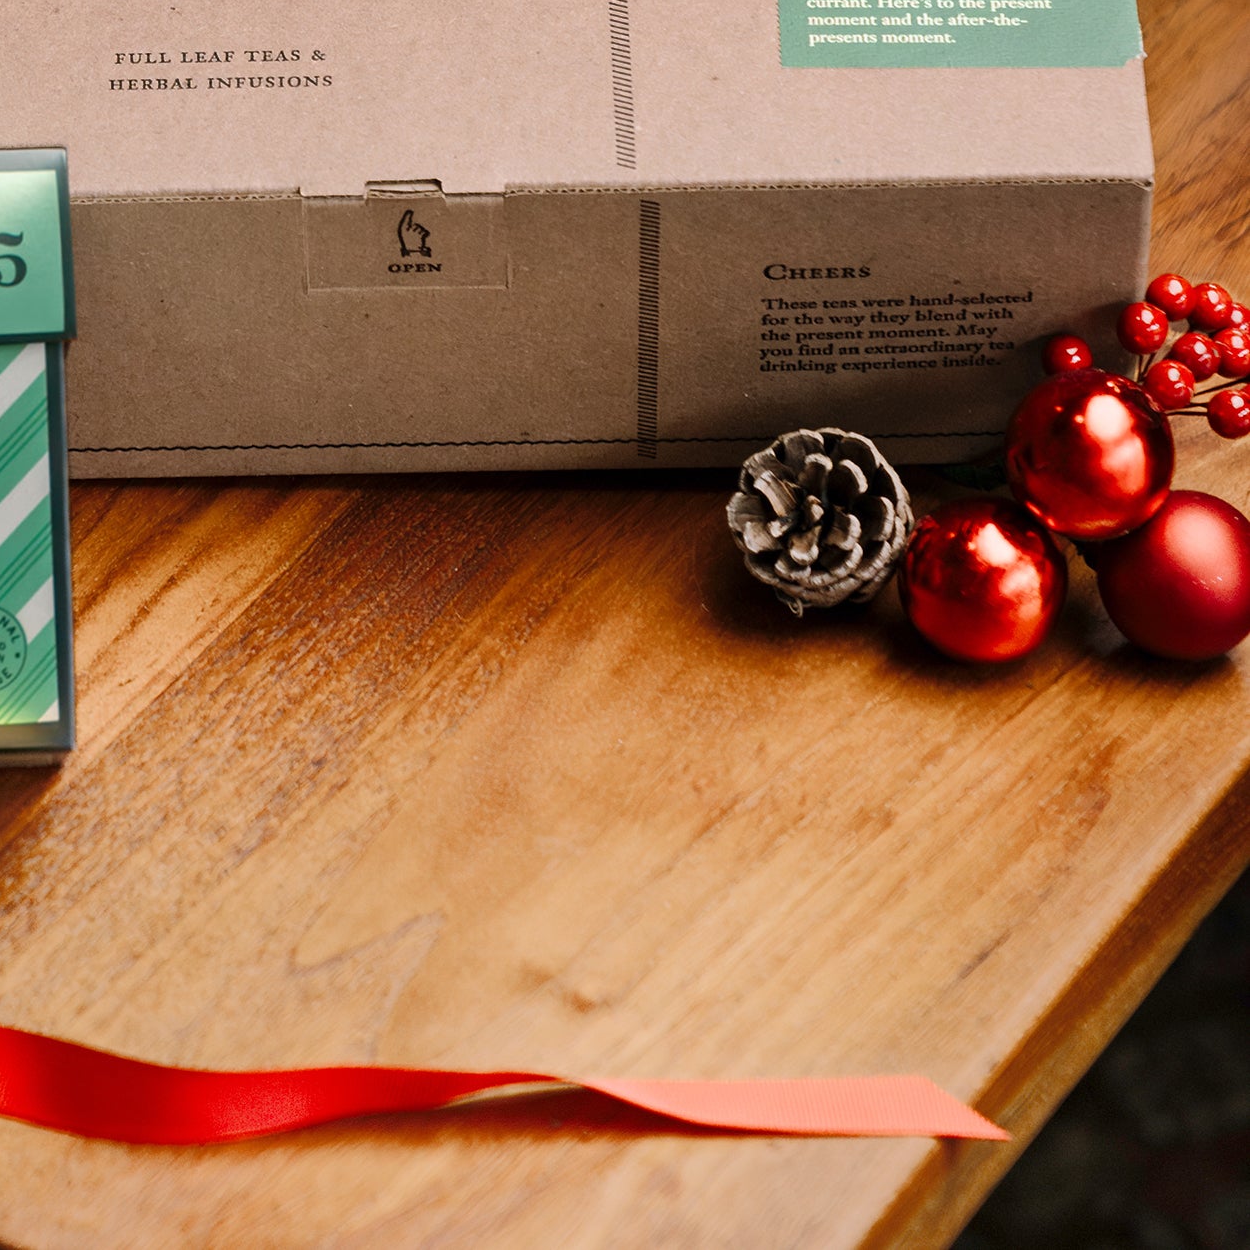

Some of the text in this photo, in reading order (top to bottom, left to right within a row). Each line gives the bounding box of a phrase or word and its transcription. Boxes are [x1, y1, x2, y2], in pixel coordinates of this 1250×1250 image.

[808, 13, 1028, 26] moment and the after-the-
[808, 32, 956, 47] presents moment.
[115, 50, 326, 64] FULL LEAF TEAS &
[109, 75, 333, 90] HERBAL INFUSIONS
[388, 263, 442, 273] OPEN
[761, 291, 1033, 310] These teas were hand-selected
[761, 308, 1014, 326] for the way they blend with
[761, 325, 997, 343] the present moment. May
[760, 341, 1014, 360] you find an extraordinary tea
[760, 355, 1001, 374] drinking experience inside.
